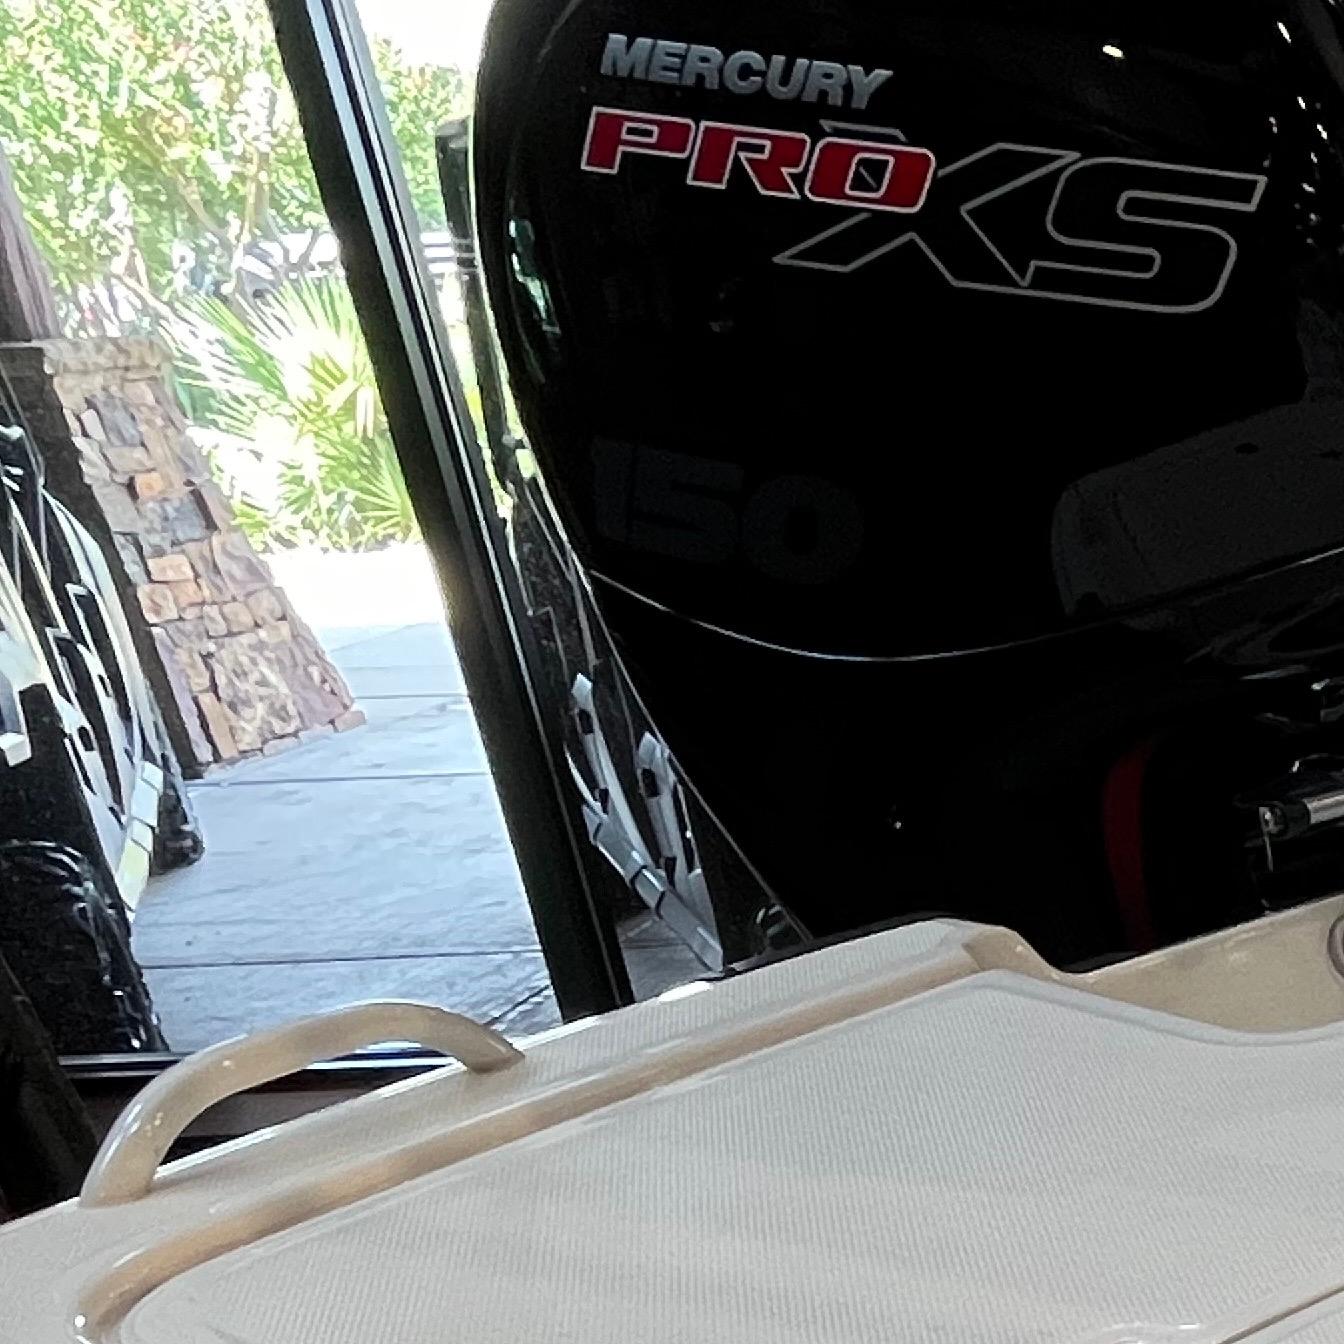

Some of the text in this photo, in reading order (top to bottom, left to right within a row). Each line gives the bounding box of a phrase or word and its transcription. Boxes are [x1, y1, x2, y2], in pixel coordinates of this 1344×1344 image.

[601, 33, 893, 109] MERCURY
[581, 106, 1267, 313] PRO XS
[592, 437, 865, 585] 150
